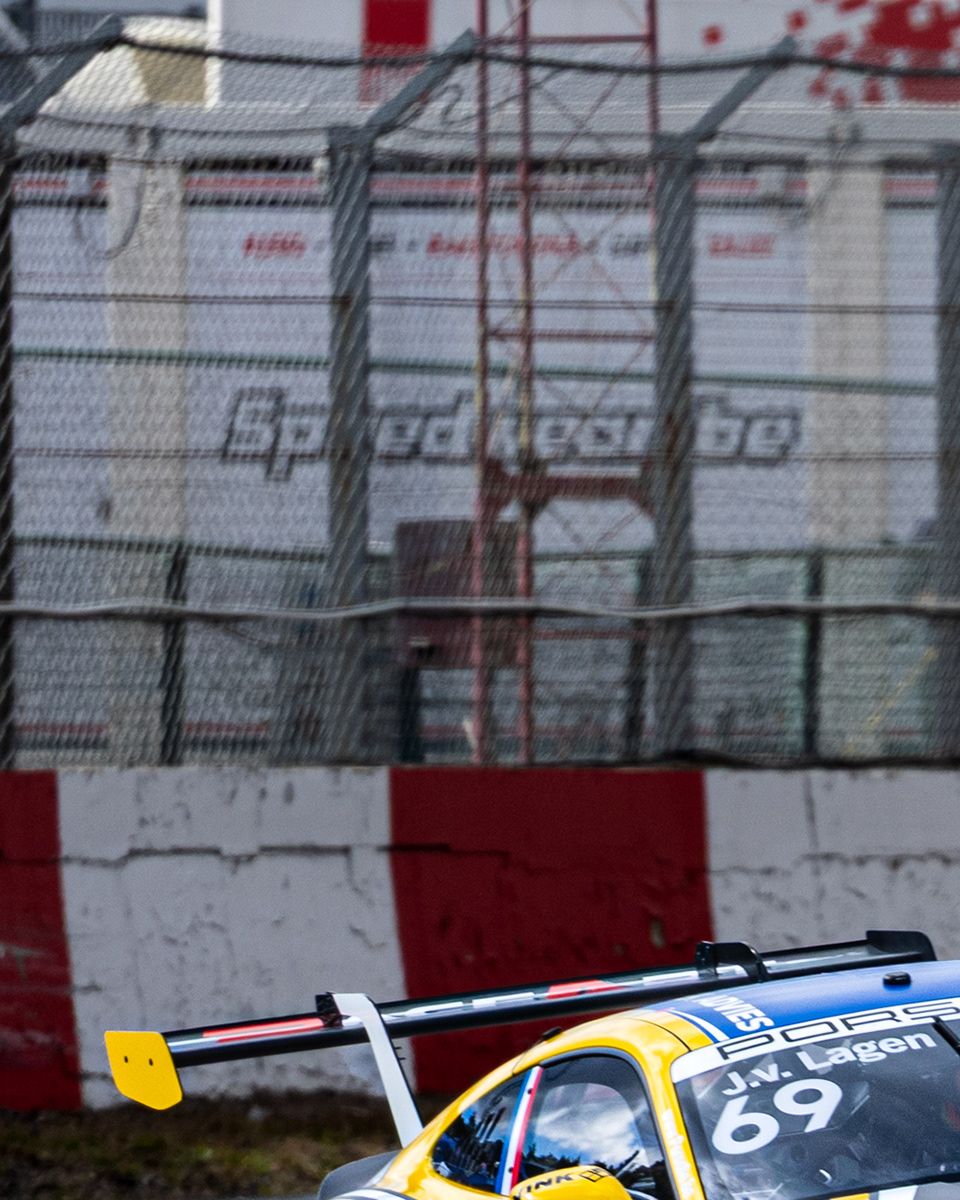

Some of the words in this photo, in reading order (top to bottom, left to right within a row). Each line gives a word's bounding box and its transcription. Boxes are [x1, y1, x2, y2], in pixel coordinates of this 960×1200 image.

[721, 1062, 793, 1096] J.v.
[796, 1031, 938, 1073] Lagen
[711, 1078, 843, 1155] 69
